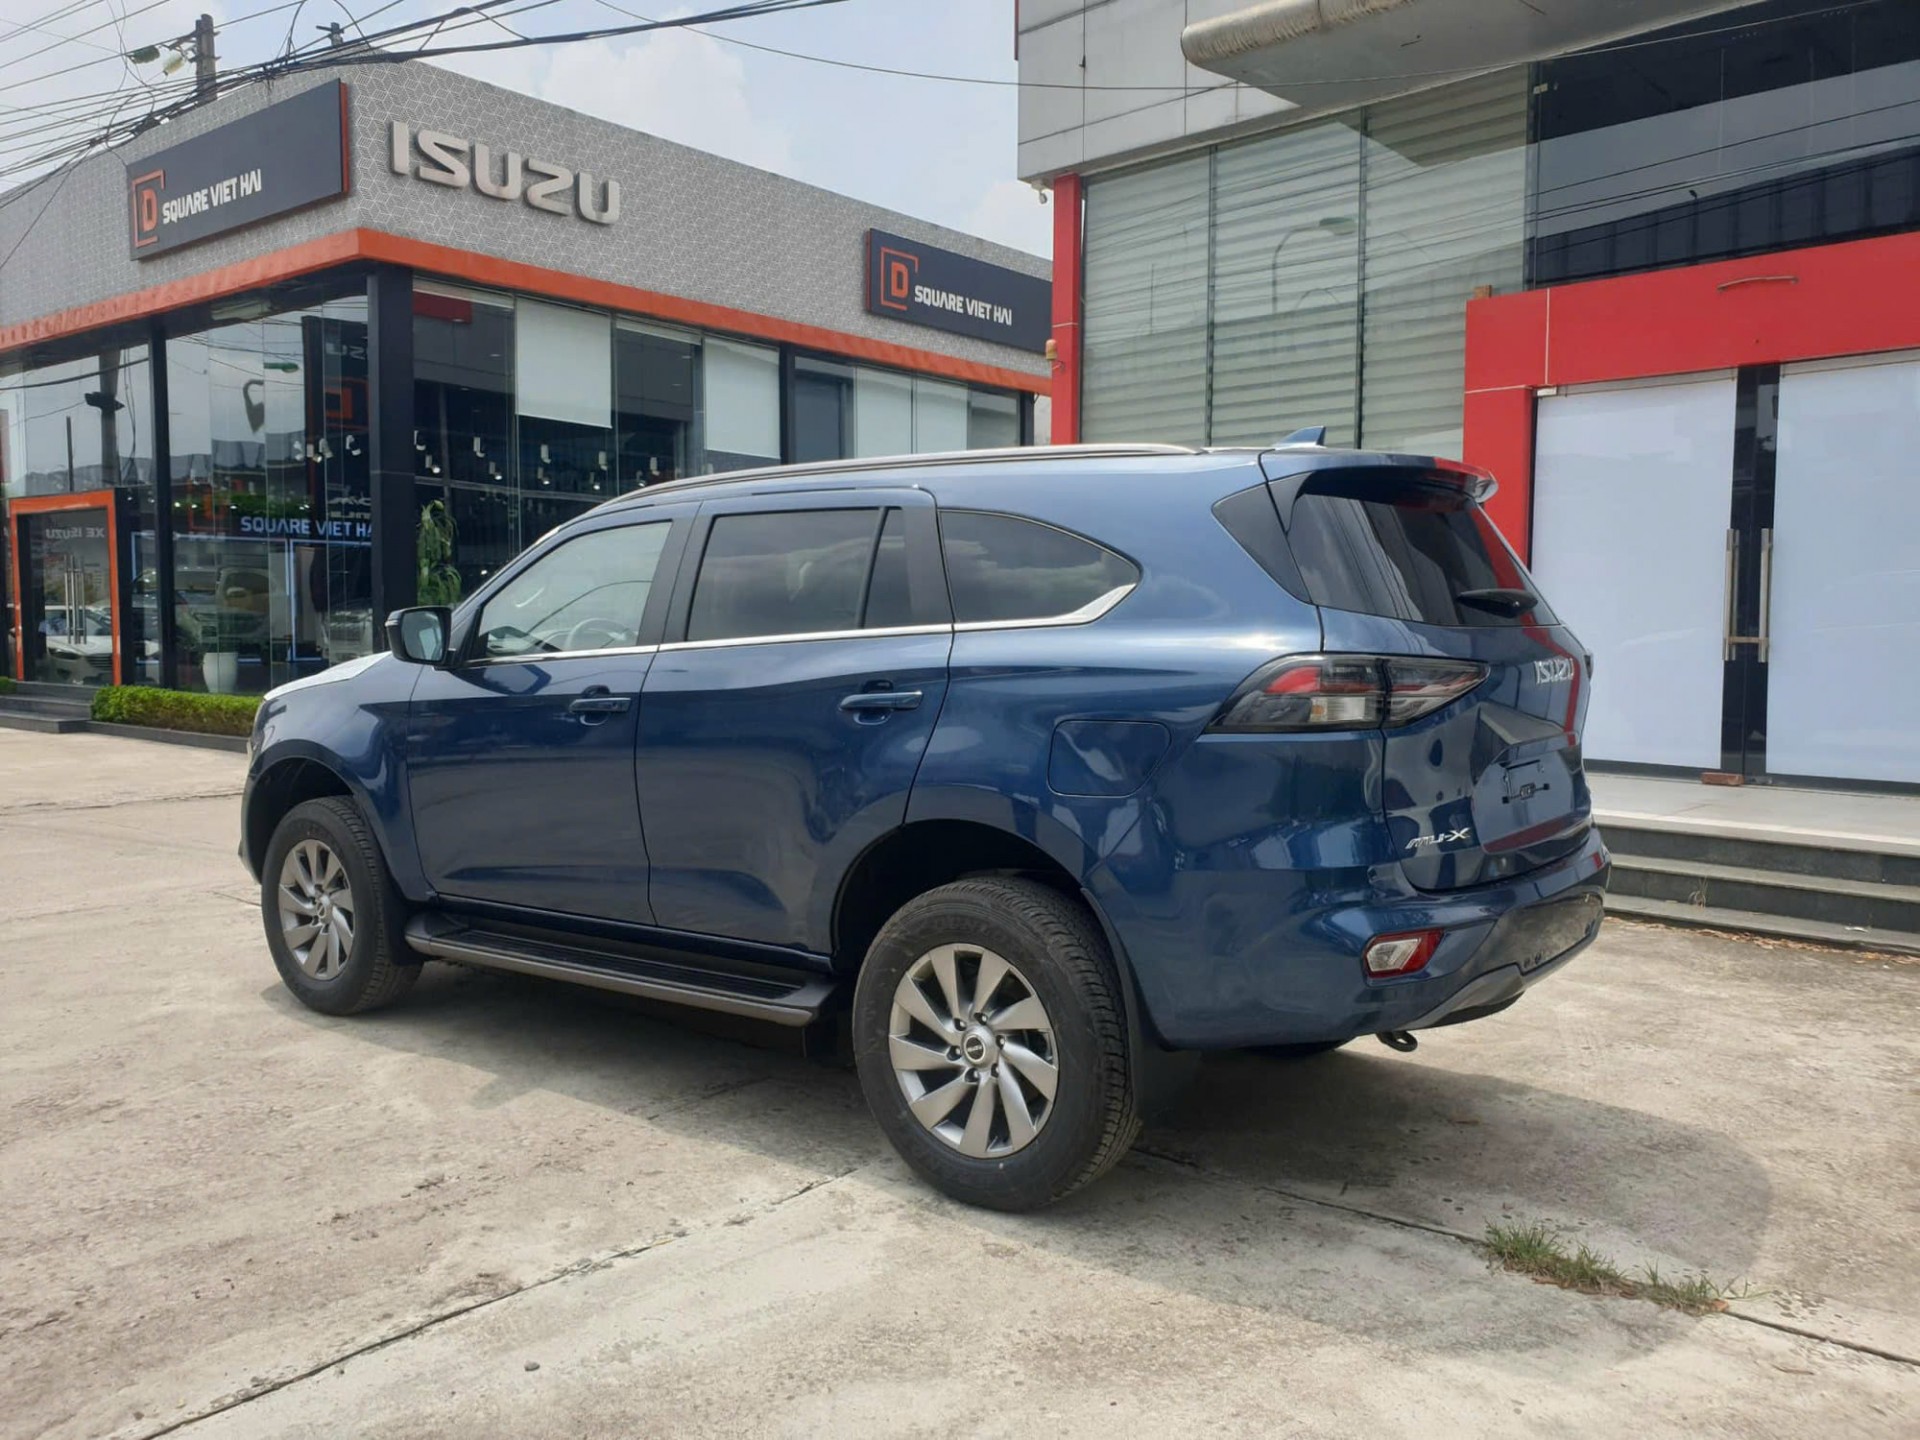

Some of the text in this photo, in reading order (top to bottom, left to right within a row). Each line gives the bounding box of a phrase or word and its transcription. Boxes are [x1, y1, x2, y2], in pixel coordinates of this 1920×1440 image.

[389, 120, 620, 225] ISUZU
[162, 189, 209, 224] SQUARE
[210, 177, 238, 207] VIET
[240, 168, 262, 197] HAI
[914, 285, 964, 314] SQUARE
[966, 297, 992, 320] VIET
[993, 305, 1012, 326] HAI
[240, 516, 311, 534] SQUARE
[315, 520, 352, 537] VIET
[1533, 657, 1575, 684] ISUZU
